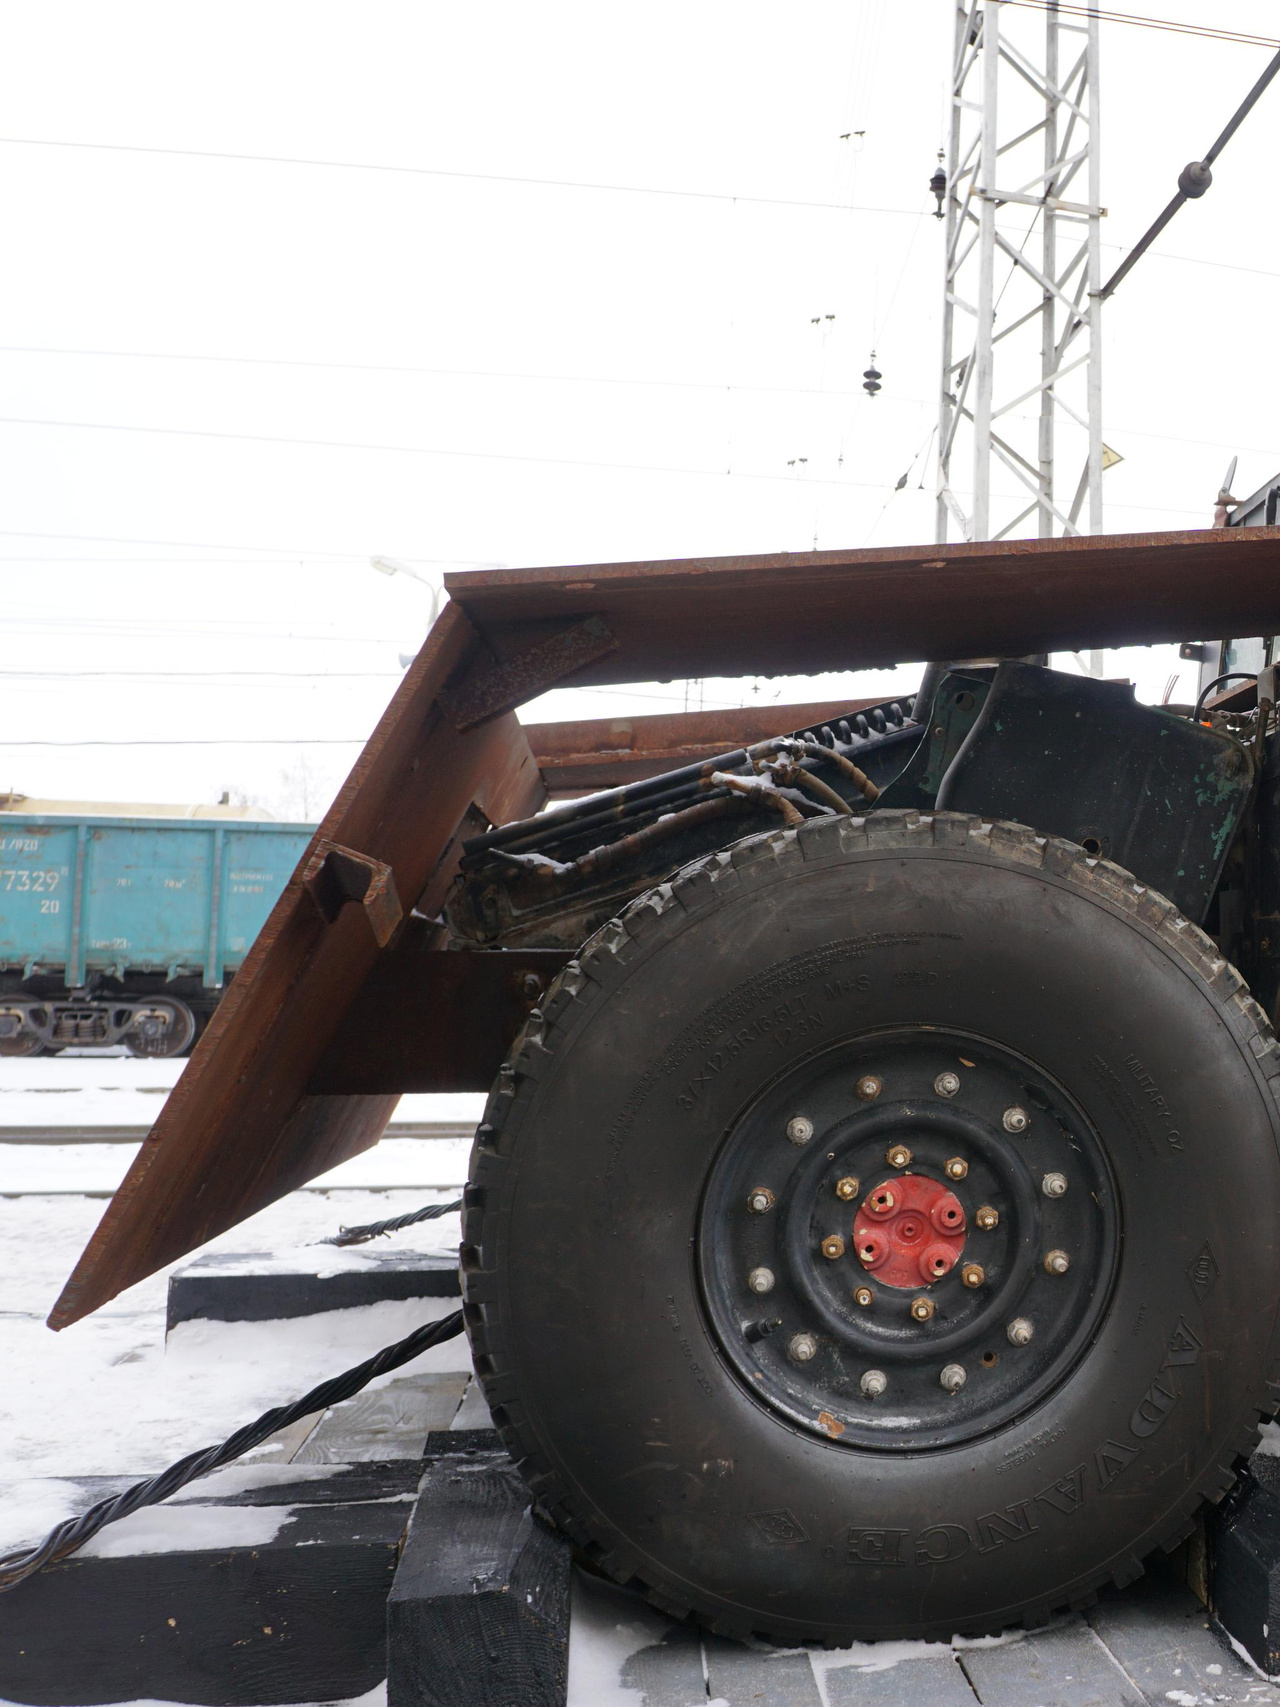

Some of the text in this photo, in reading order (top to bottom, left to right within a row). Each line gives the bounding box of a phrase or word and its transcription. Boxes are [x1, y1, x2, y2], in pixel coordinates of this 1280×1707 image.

[0, 869, 60, 892] 7329
[40, 899, 60, 914] 20
[1123, 1051, 1170, 1120] MILITARY
[846, 1314, 1203, 1567] ADVANCE
